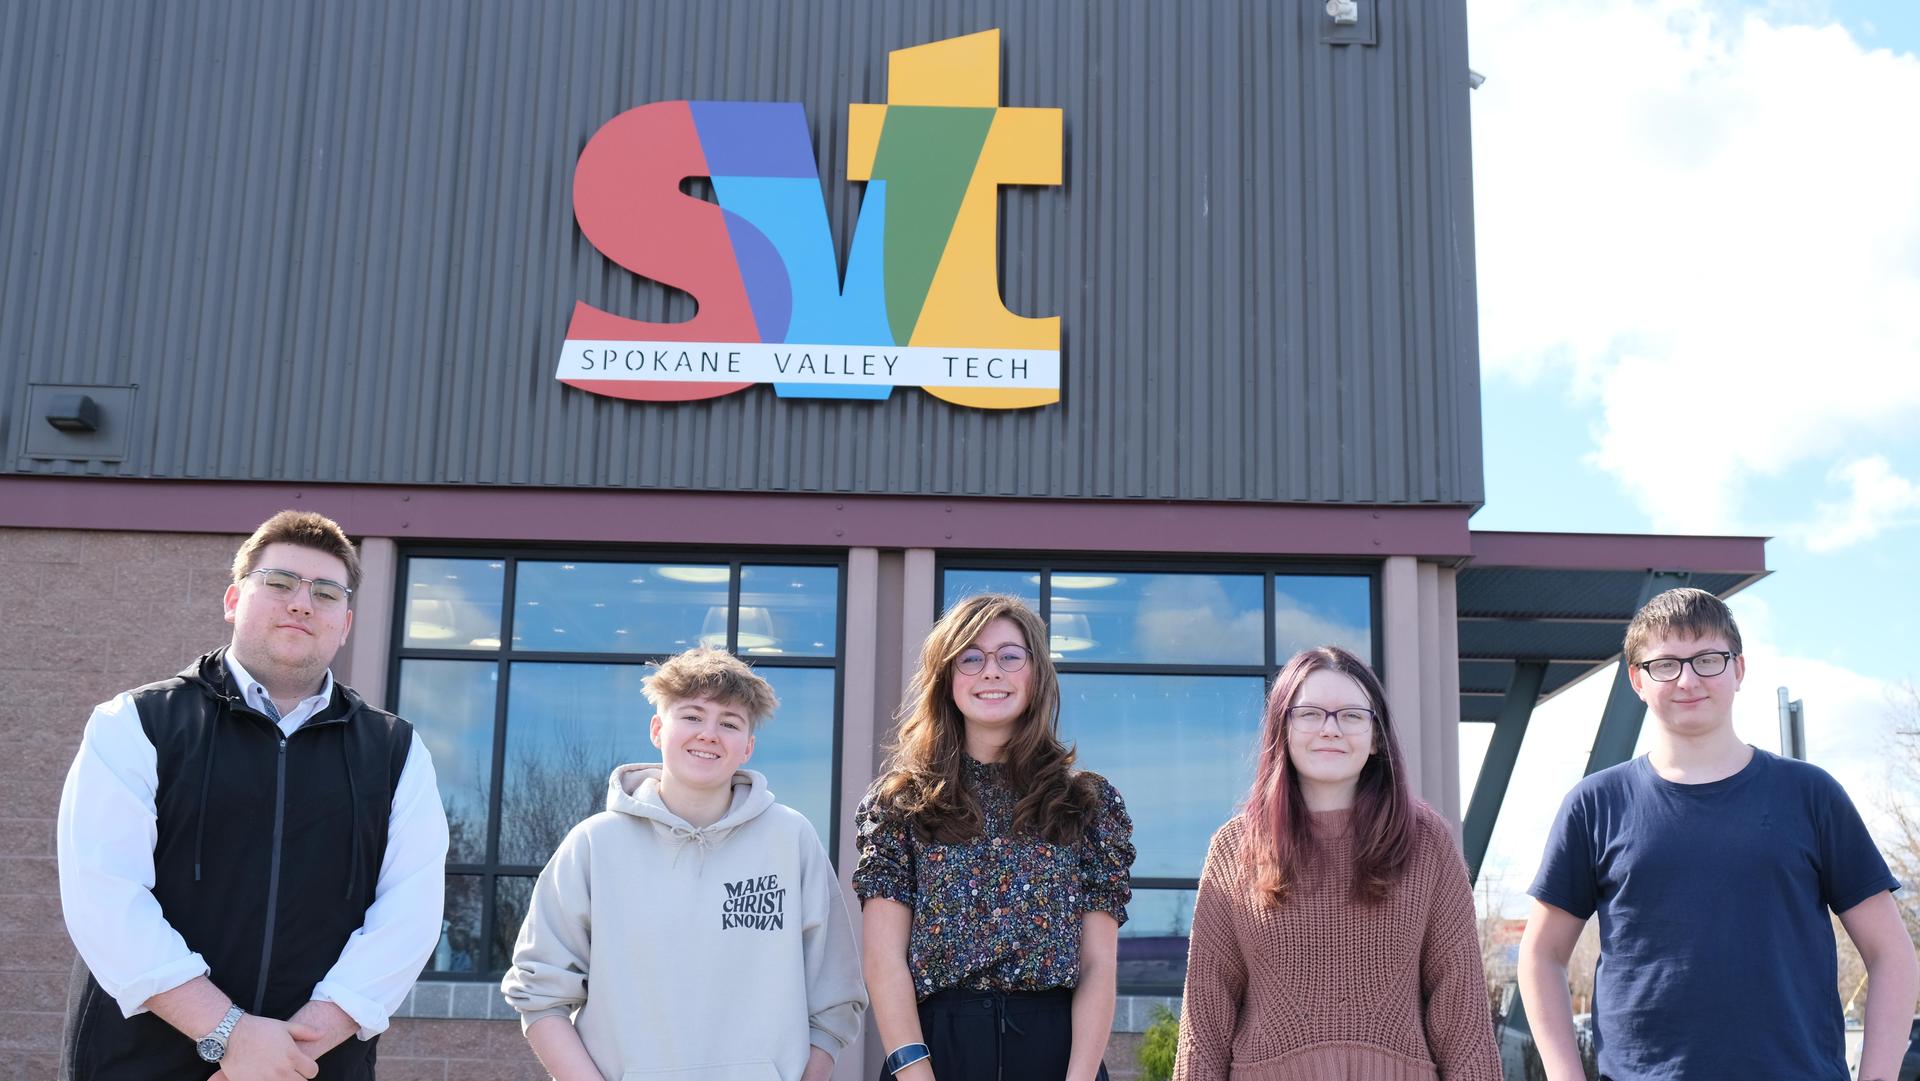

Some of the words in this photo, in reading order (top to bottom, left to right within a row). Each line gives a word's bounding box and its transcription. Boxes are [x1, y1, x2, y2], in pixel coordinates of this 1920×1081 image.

[580, 349, 741, 373] SPOKANE
[774, 353, 899, 376] VALLEY
[942, 357, 1028, 379] TECH
[723, 874, 779, 899] MAKE
[722, 888, 786, 915] CHRIST
[721, 912, 784, 931] KNOWN
